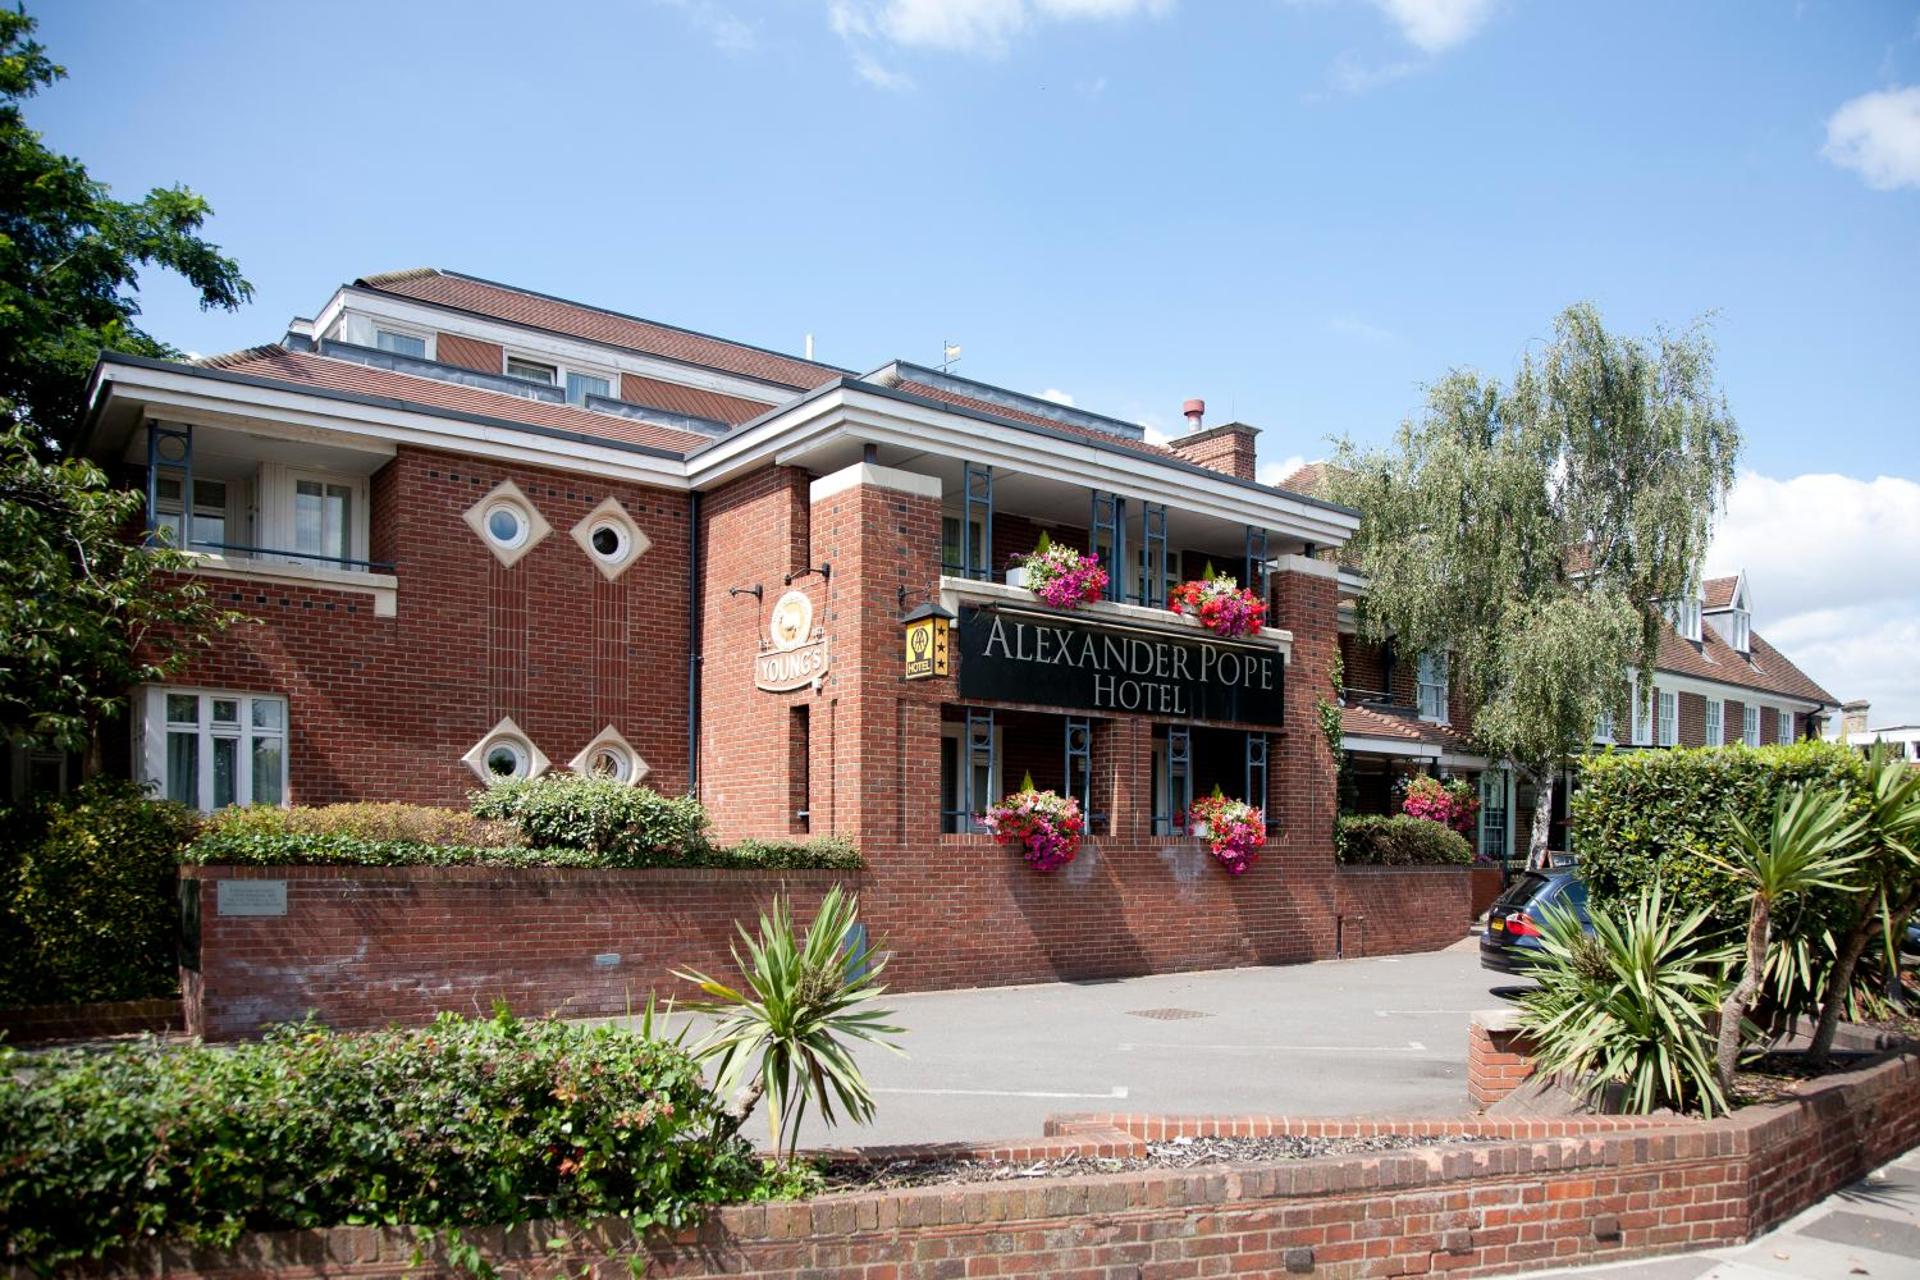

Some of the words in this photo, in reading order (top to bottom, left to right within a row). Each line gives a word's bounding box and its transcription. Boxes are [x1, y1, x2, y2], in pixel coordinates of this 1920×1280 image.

[761, 649, 821, 681] YOUNG'S
[908, 660, 930, 674] HOTEL
[983, 615, 1193, 680] ALEXANDER
[1199, 644, 1272, 689] POPE
[1094, 674, 1186, 713] HOTEL
